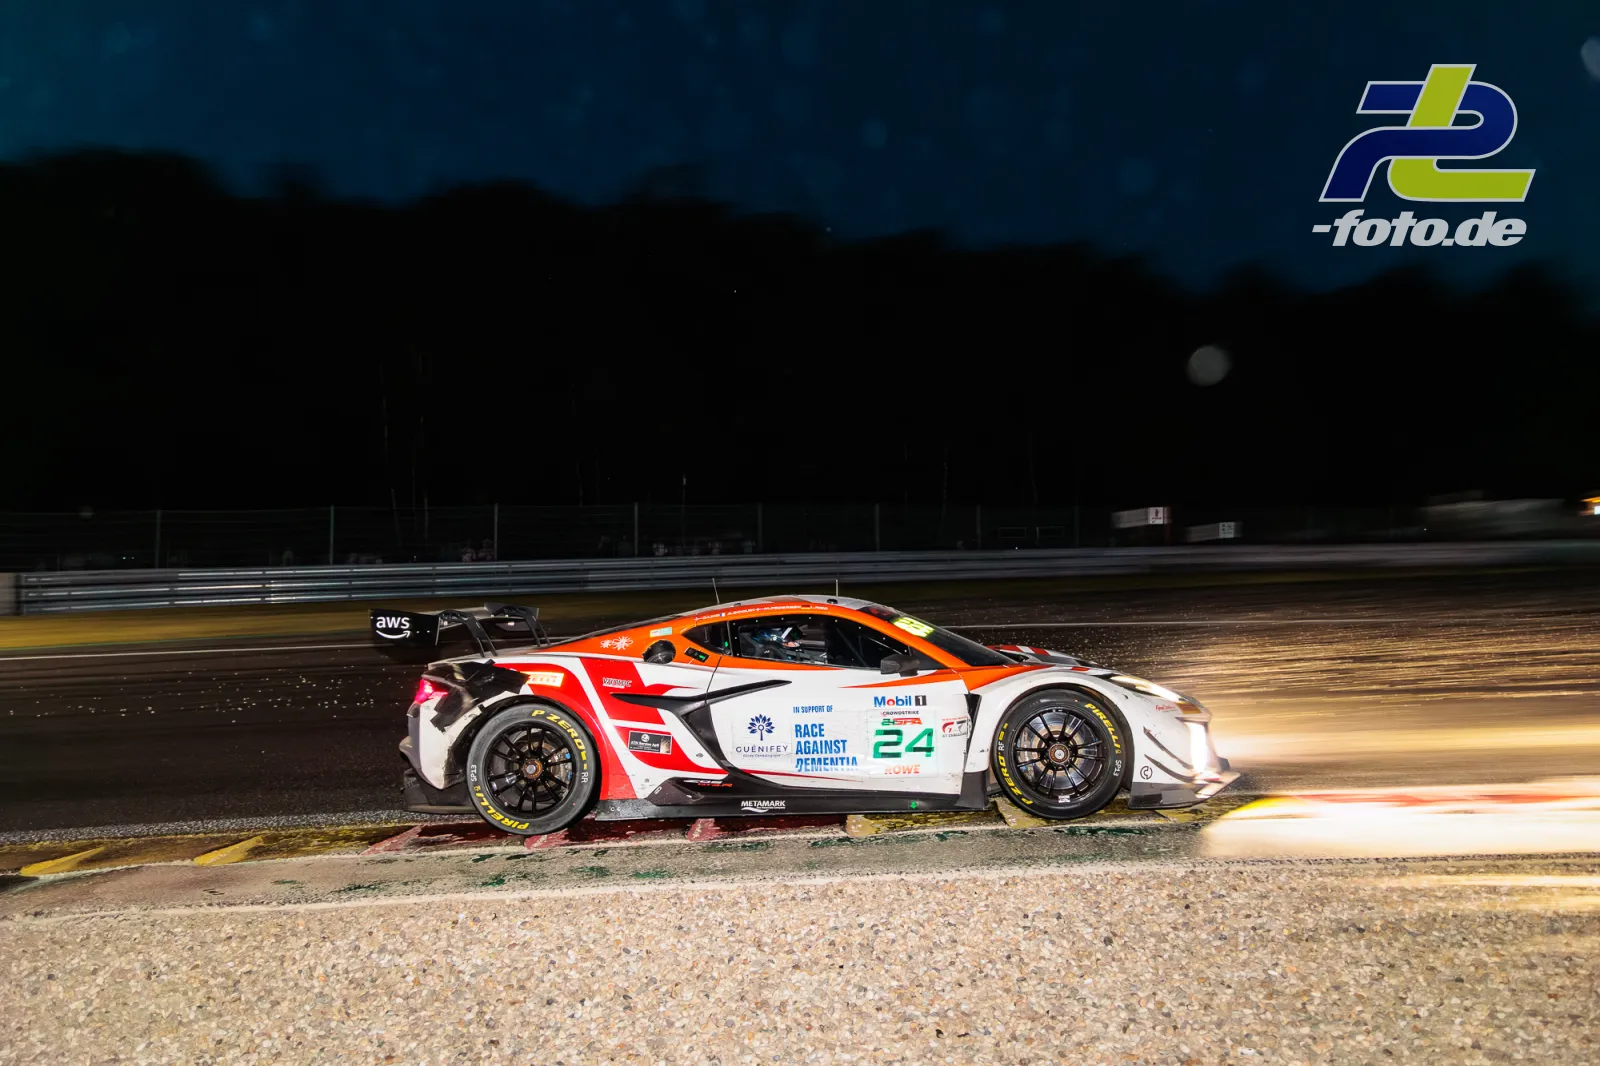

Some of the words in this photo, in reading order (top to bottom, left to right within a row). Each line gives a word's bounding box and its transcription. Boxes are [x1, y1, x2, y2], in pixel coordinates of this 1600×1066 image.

[376, 616, 411, 630] aws
[873, 695, 912, 707] Mobil
[915, 695, 927, 706] 1
[801, 705, 825, 713] SUPPORT
[826, 705, 833, 713] OF
[531, 709, 545, 717] P
[546, 713, 586, 750] ZERO
[794, 723, 825, 738] RACE
[1084, 703, 1121, 751] PIRELLI
[795, 739, 848, 755] AGAINST
[873, 728, 934, 759] 24
[998, 741, 1005, 751] RF
[795, 756, 860, 773] DEMENTIA
[884, 764, 920, 775] ROWE
[997, 755, 1022, 796] ZERO
[1021, 797, 1033, 805] P
[475, 792, 530, 830] PIRELLI
